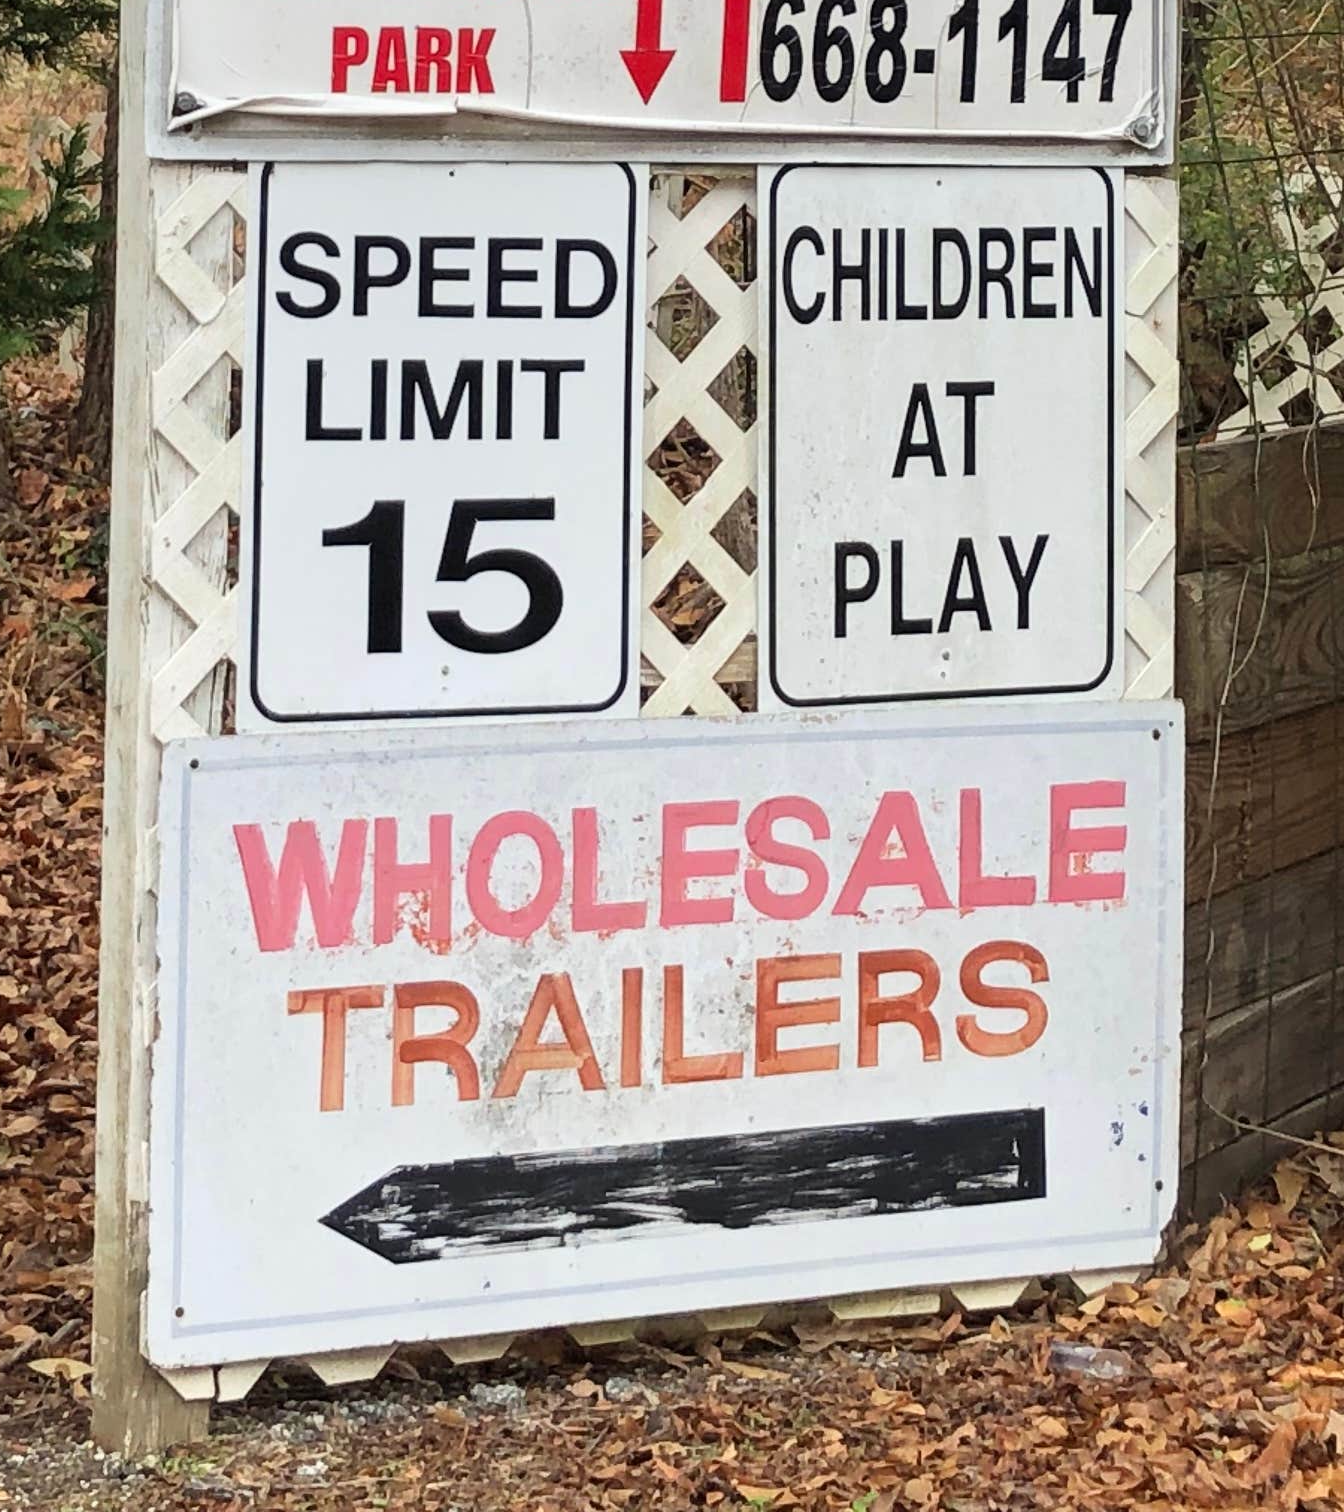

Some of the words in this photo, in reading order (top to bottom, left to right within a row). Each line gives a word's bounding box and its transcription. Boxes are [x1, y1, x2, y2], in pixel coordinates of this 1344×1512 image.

[330, 27, 497, 94] PARK
[275, 231, 619, 319] SPEED
[781, 225, 1103, 325] CHILDREN
[304, 358, 586, 442] LIMIT
[891, 381, 995, 479] AT
[321, 497, 564, 655] 15
[834, 533, 1050, 639] PLAY
[232, 779, 1128, 954] WHOLESALE
[287, 940, 1050, 1113] TRAILERS
